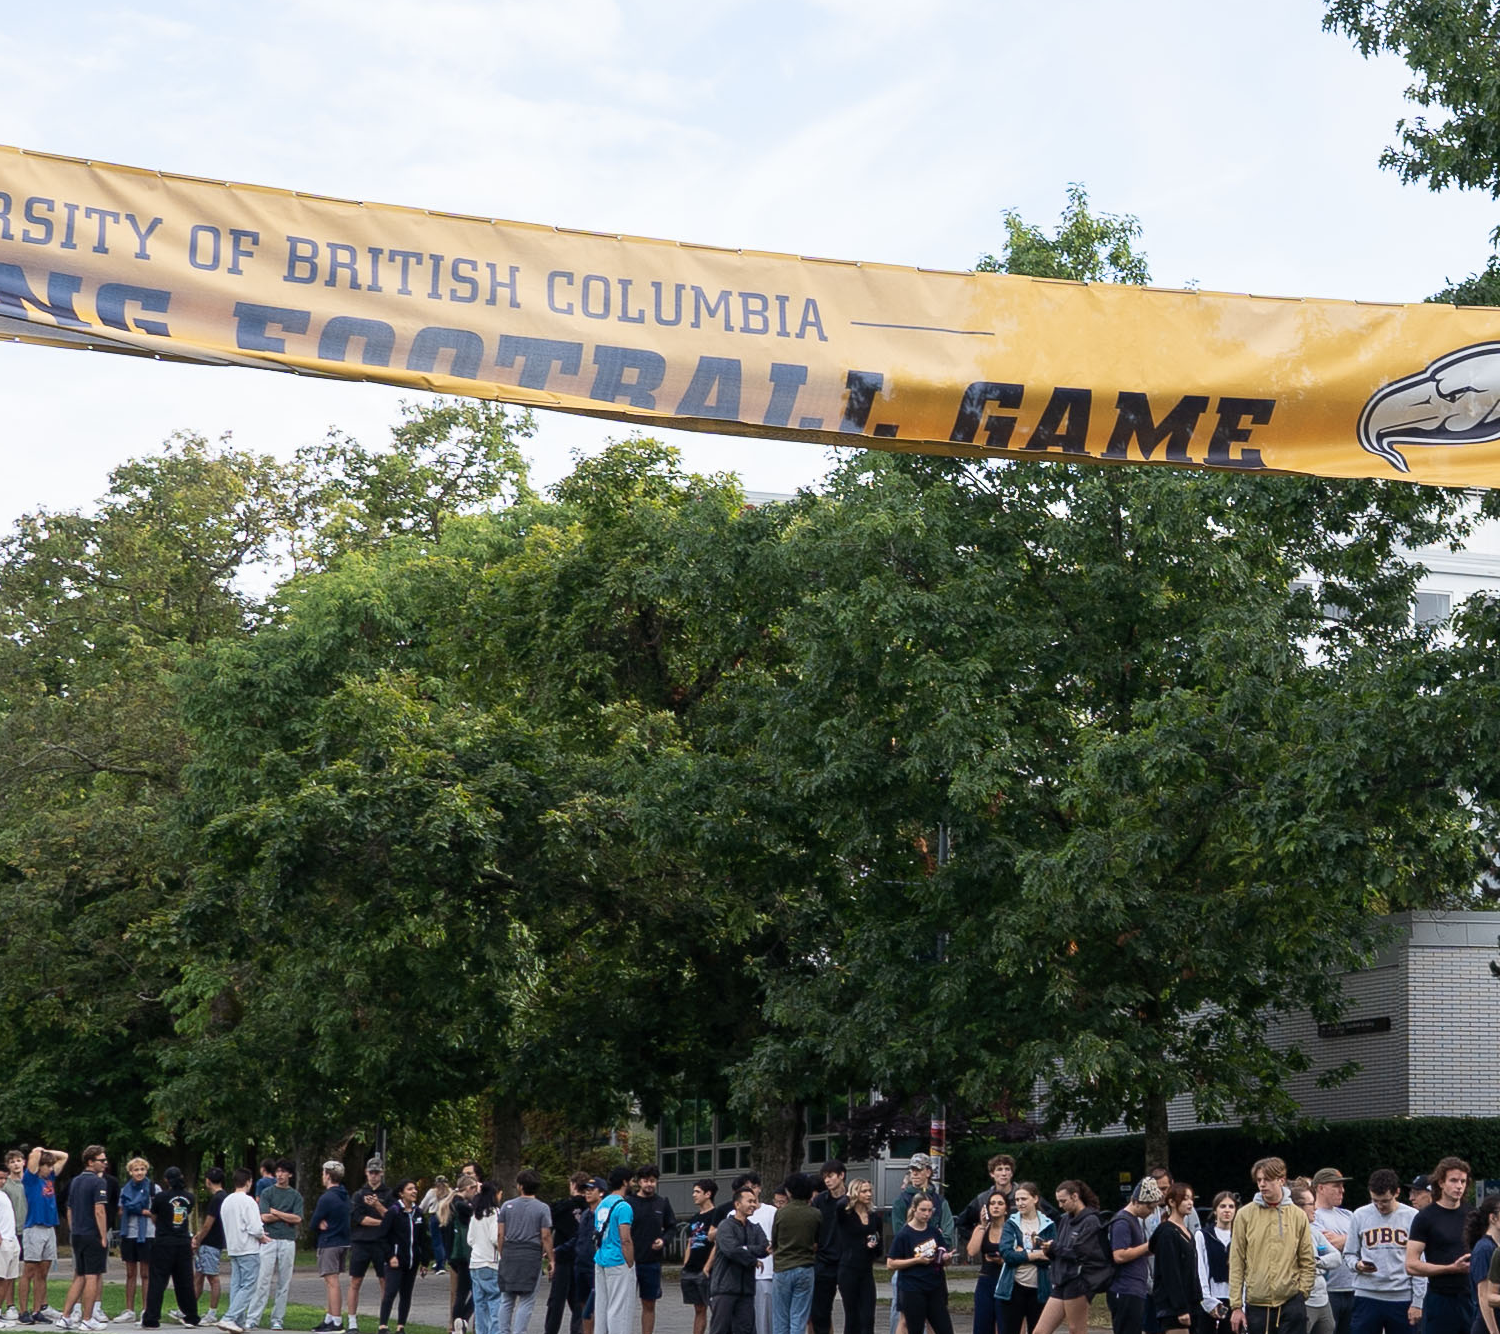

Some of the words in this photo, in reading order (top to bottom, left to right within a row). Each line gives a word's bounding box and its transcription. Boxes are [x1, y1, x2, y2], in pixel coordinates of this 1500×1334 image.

[189, 224, 260, 276] OF
[283, 235, 522, 310] BRITISH
[546, 270, 829, 343] COLUMBIA
[949, 381, 1277, 469] GAME
[1364, 1227, 1408, 1247] UBC
